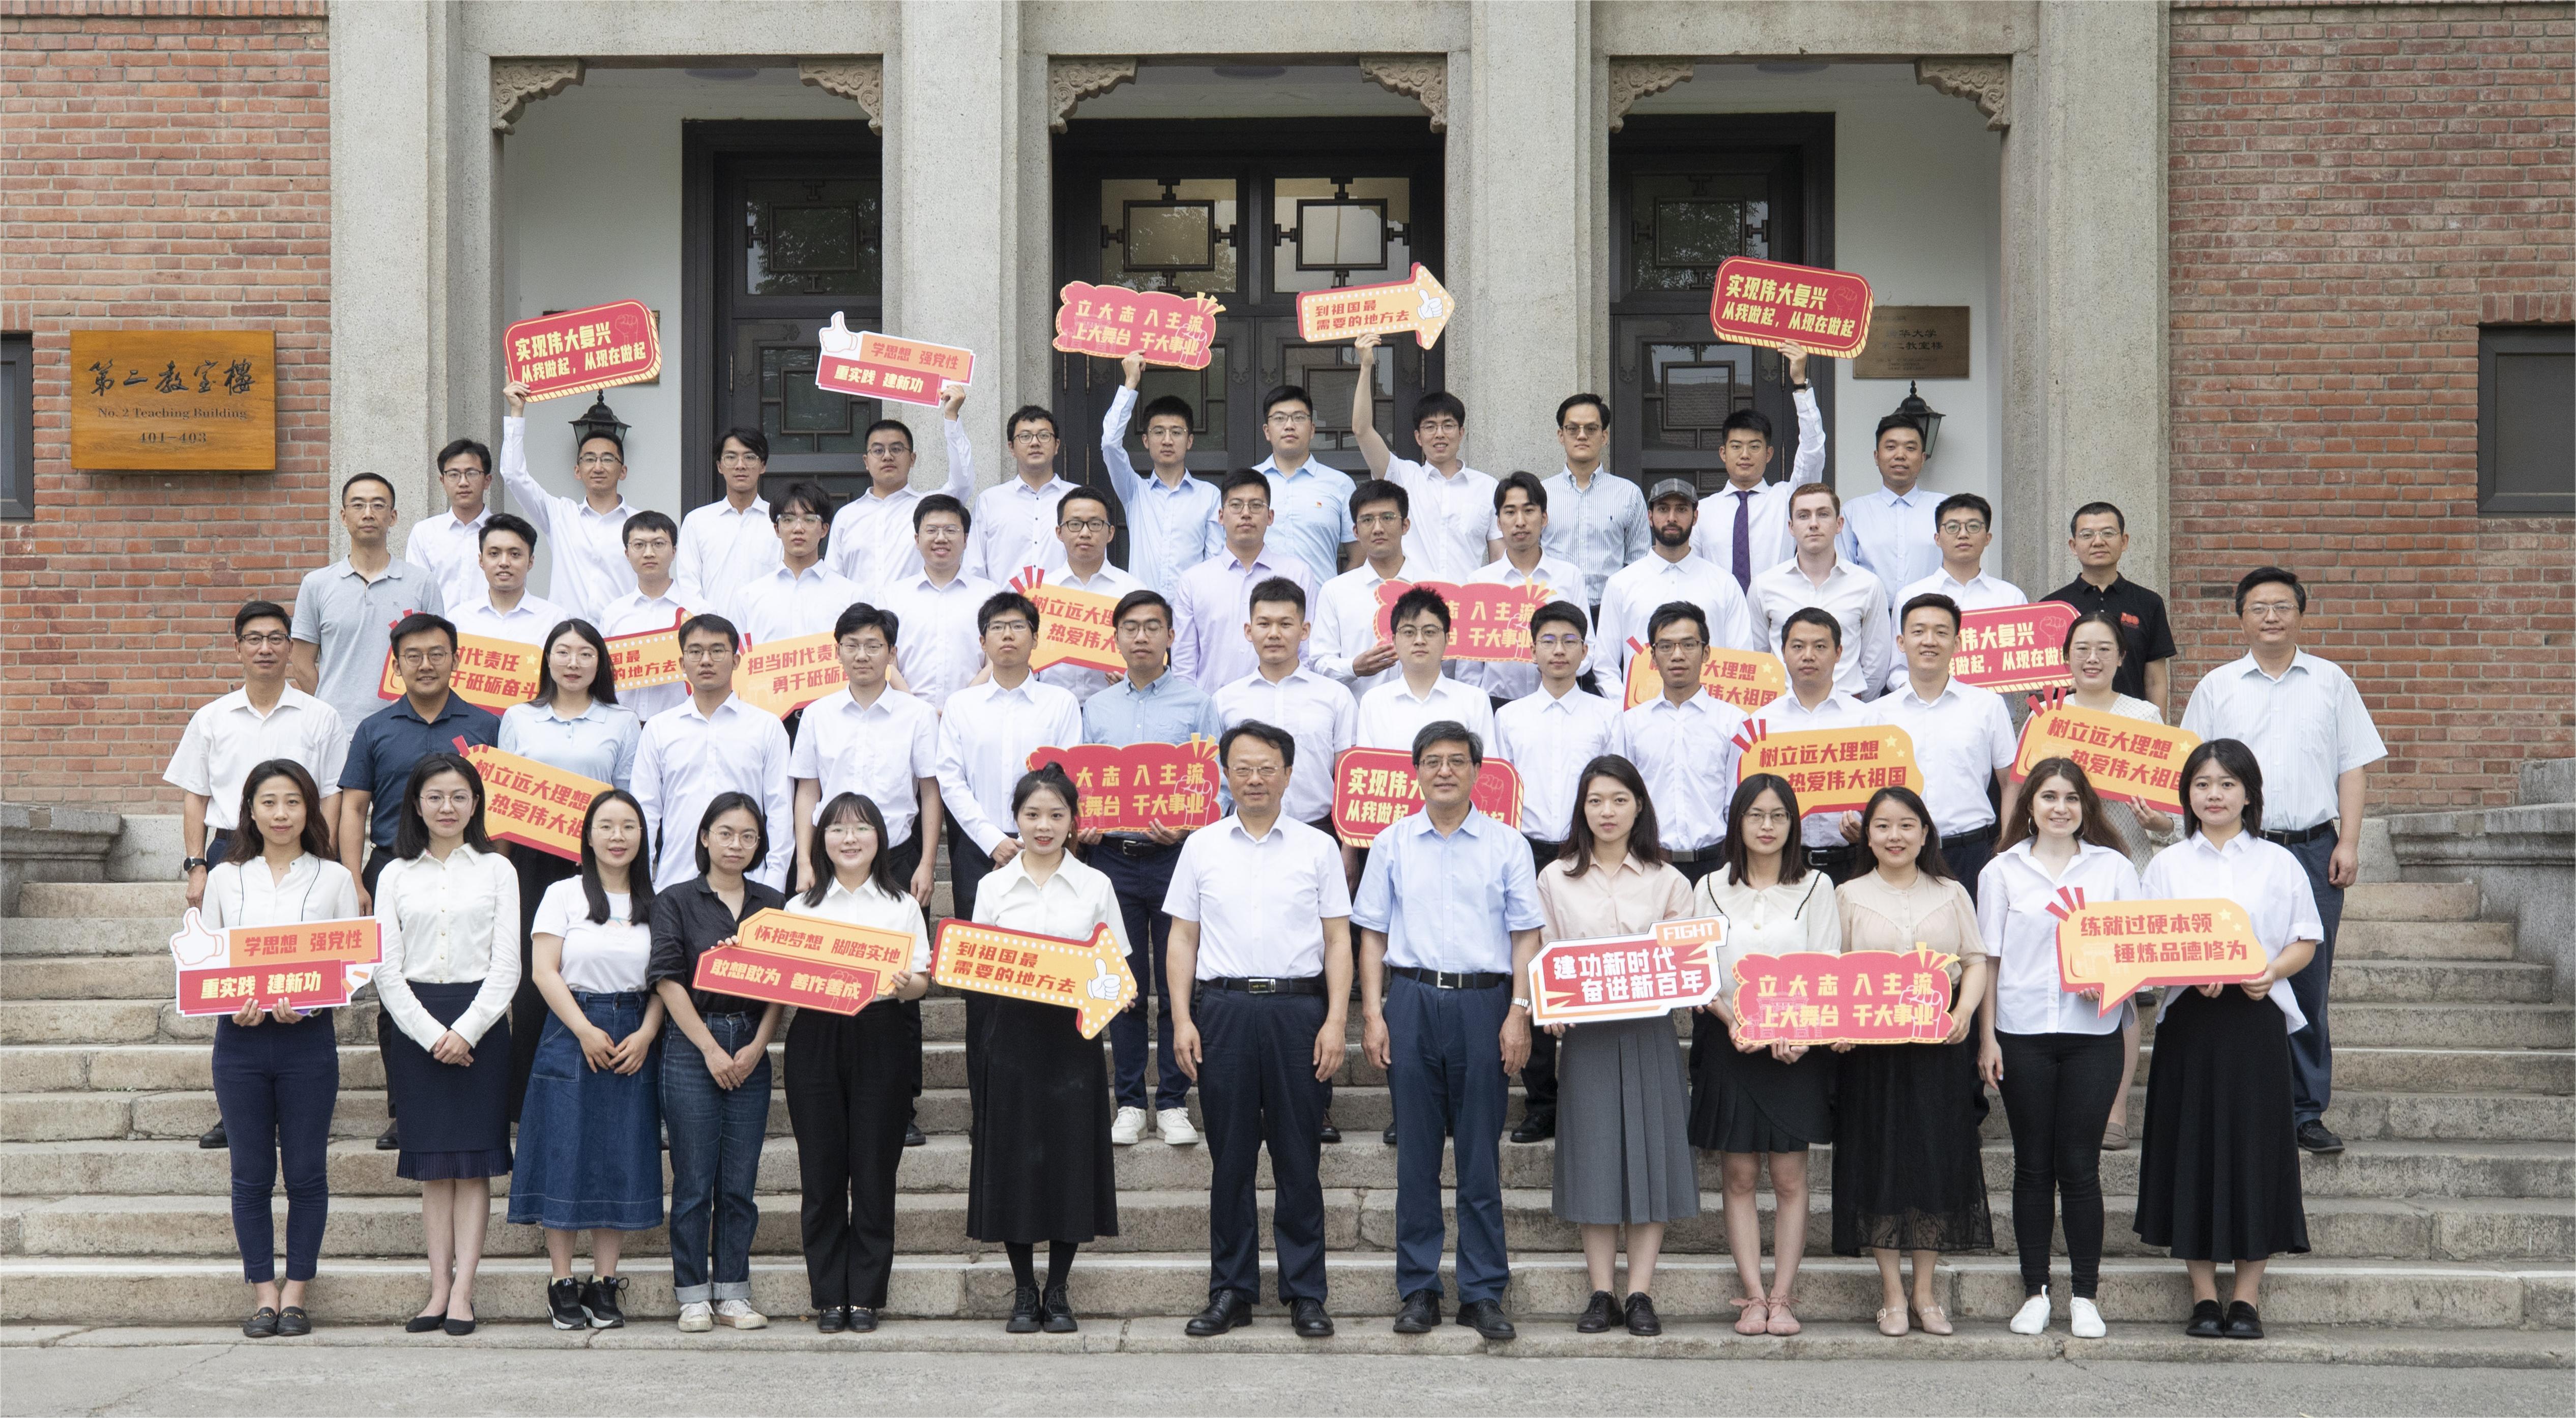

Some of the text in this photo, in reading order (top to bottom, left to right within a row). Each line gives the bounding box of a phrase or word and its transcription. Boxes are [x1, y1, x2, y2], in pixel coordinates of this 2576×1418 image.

[1725, 274, 1829, 310] 实现伟大复兴
[1315, 300, 1377, 317] 到祖国最
[1316, 310, 1410, 331] 需要的地方去
[515, 322, 611, 362] 实现伟大复兴
[1072, 323, 1200, 356] 上大舞台 干大事业
[1882, 341, 1944, 351] 二教室楼
[871, 342, 959, 369] 学思想 强党性
[834, 364, 924, 393] 重实践 建新功
[98, 408, 248, 420] No. 2 Teaching Building
[1046, 623, 1122, 654] 热爱伟大
[1700, 660, 1757, 681] 大理想
[1700, 682, 1777, 707] 伟大祖国
[2047, 716, 2173, 760] 树立远大理想
[1759, 740, 1879, 767] 树立远大理想
[475, 759, 592, 812] 树立远大理想
[1788, 766, 1907, 793] 热爱伟大祖国
[1132, 793, 1205, 816] 干大事业
[1662, 921, 1716, 941] FIGHT
[2081, 913, 2213, 937] 练就过硬本领
[244, 929, 362, 957] 学思想 强党性
[754, 924, 901, 964] 怀抱梦想 脚踏实地
[956, 941, 1039, 969] 到祖国最
[2114, 940, 2247, 963] 锤炼品德修为
[953, 960, 1076, 994] 需要的地方去
[1553, 947, 1677, 980] 建功新时代
[200, 971, 321, 999] 重实践 建新功
[710, 958, 862, 1000] 敢想敢为 善作善成
[1581, 969, 1704, 1002] 奋进新百年
[1760, 1003, 1934, 1028] 上大舞台 干大事业
